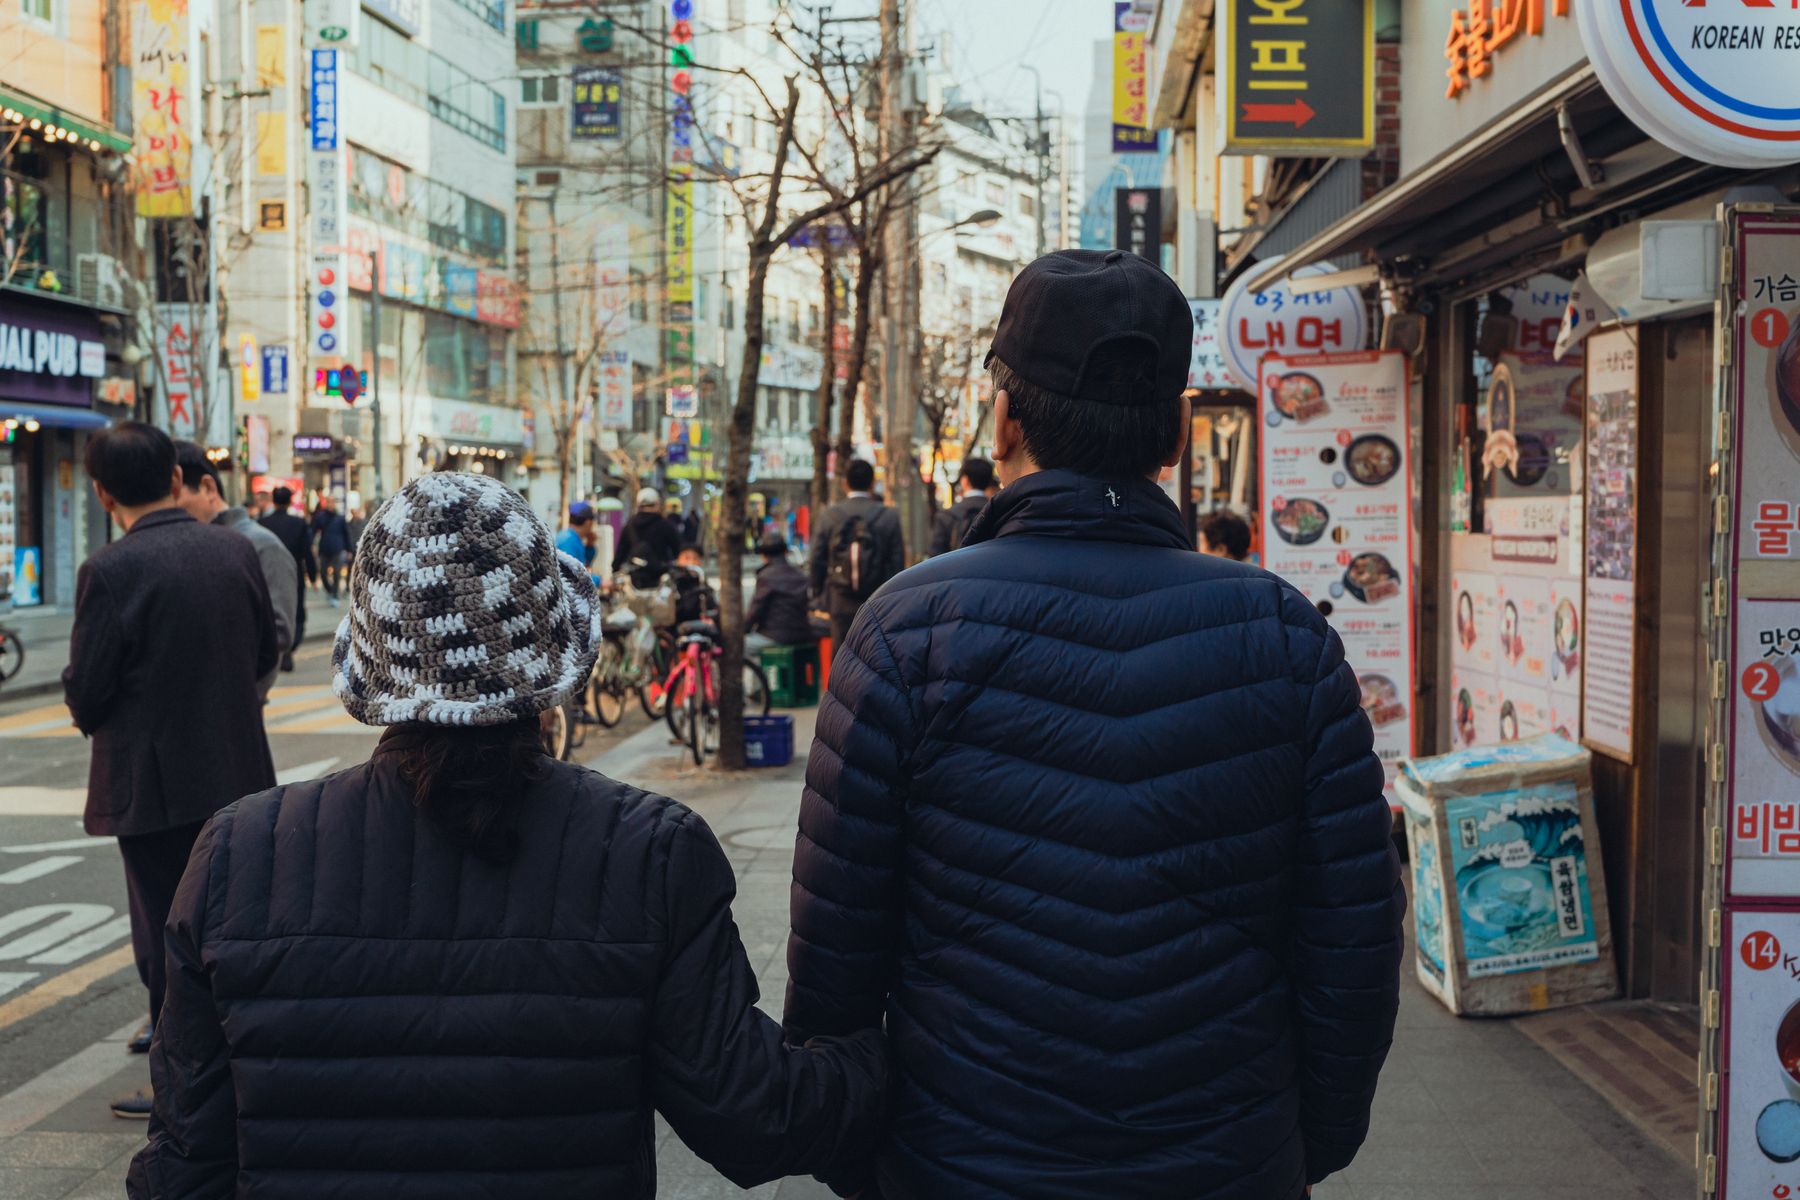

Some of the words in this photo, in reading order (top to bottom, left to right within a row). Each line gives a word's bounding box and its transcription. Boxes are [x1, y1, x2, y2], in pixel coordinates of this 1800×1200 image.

[1691, 25, 1764, 49] KOREAN
[1763, 313, 1774, 341] 1
[34, 329, 77, 377] PUB
[1754, 503, 1800, 554] 물
[1751, 667, 1768, 695] 2
[1747, 936, 1777, 963] 14
